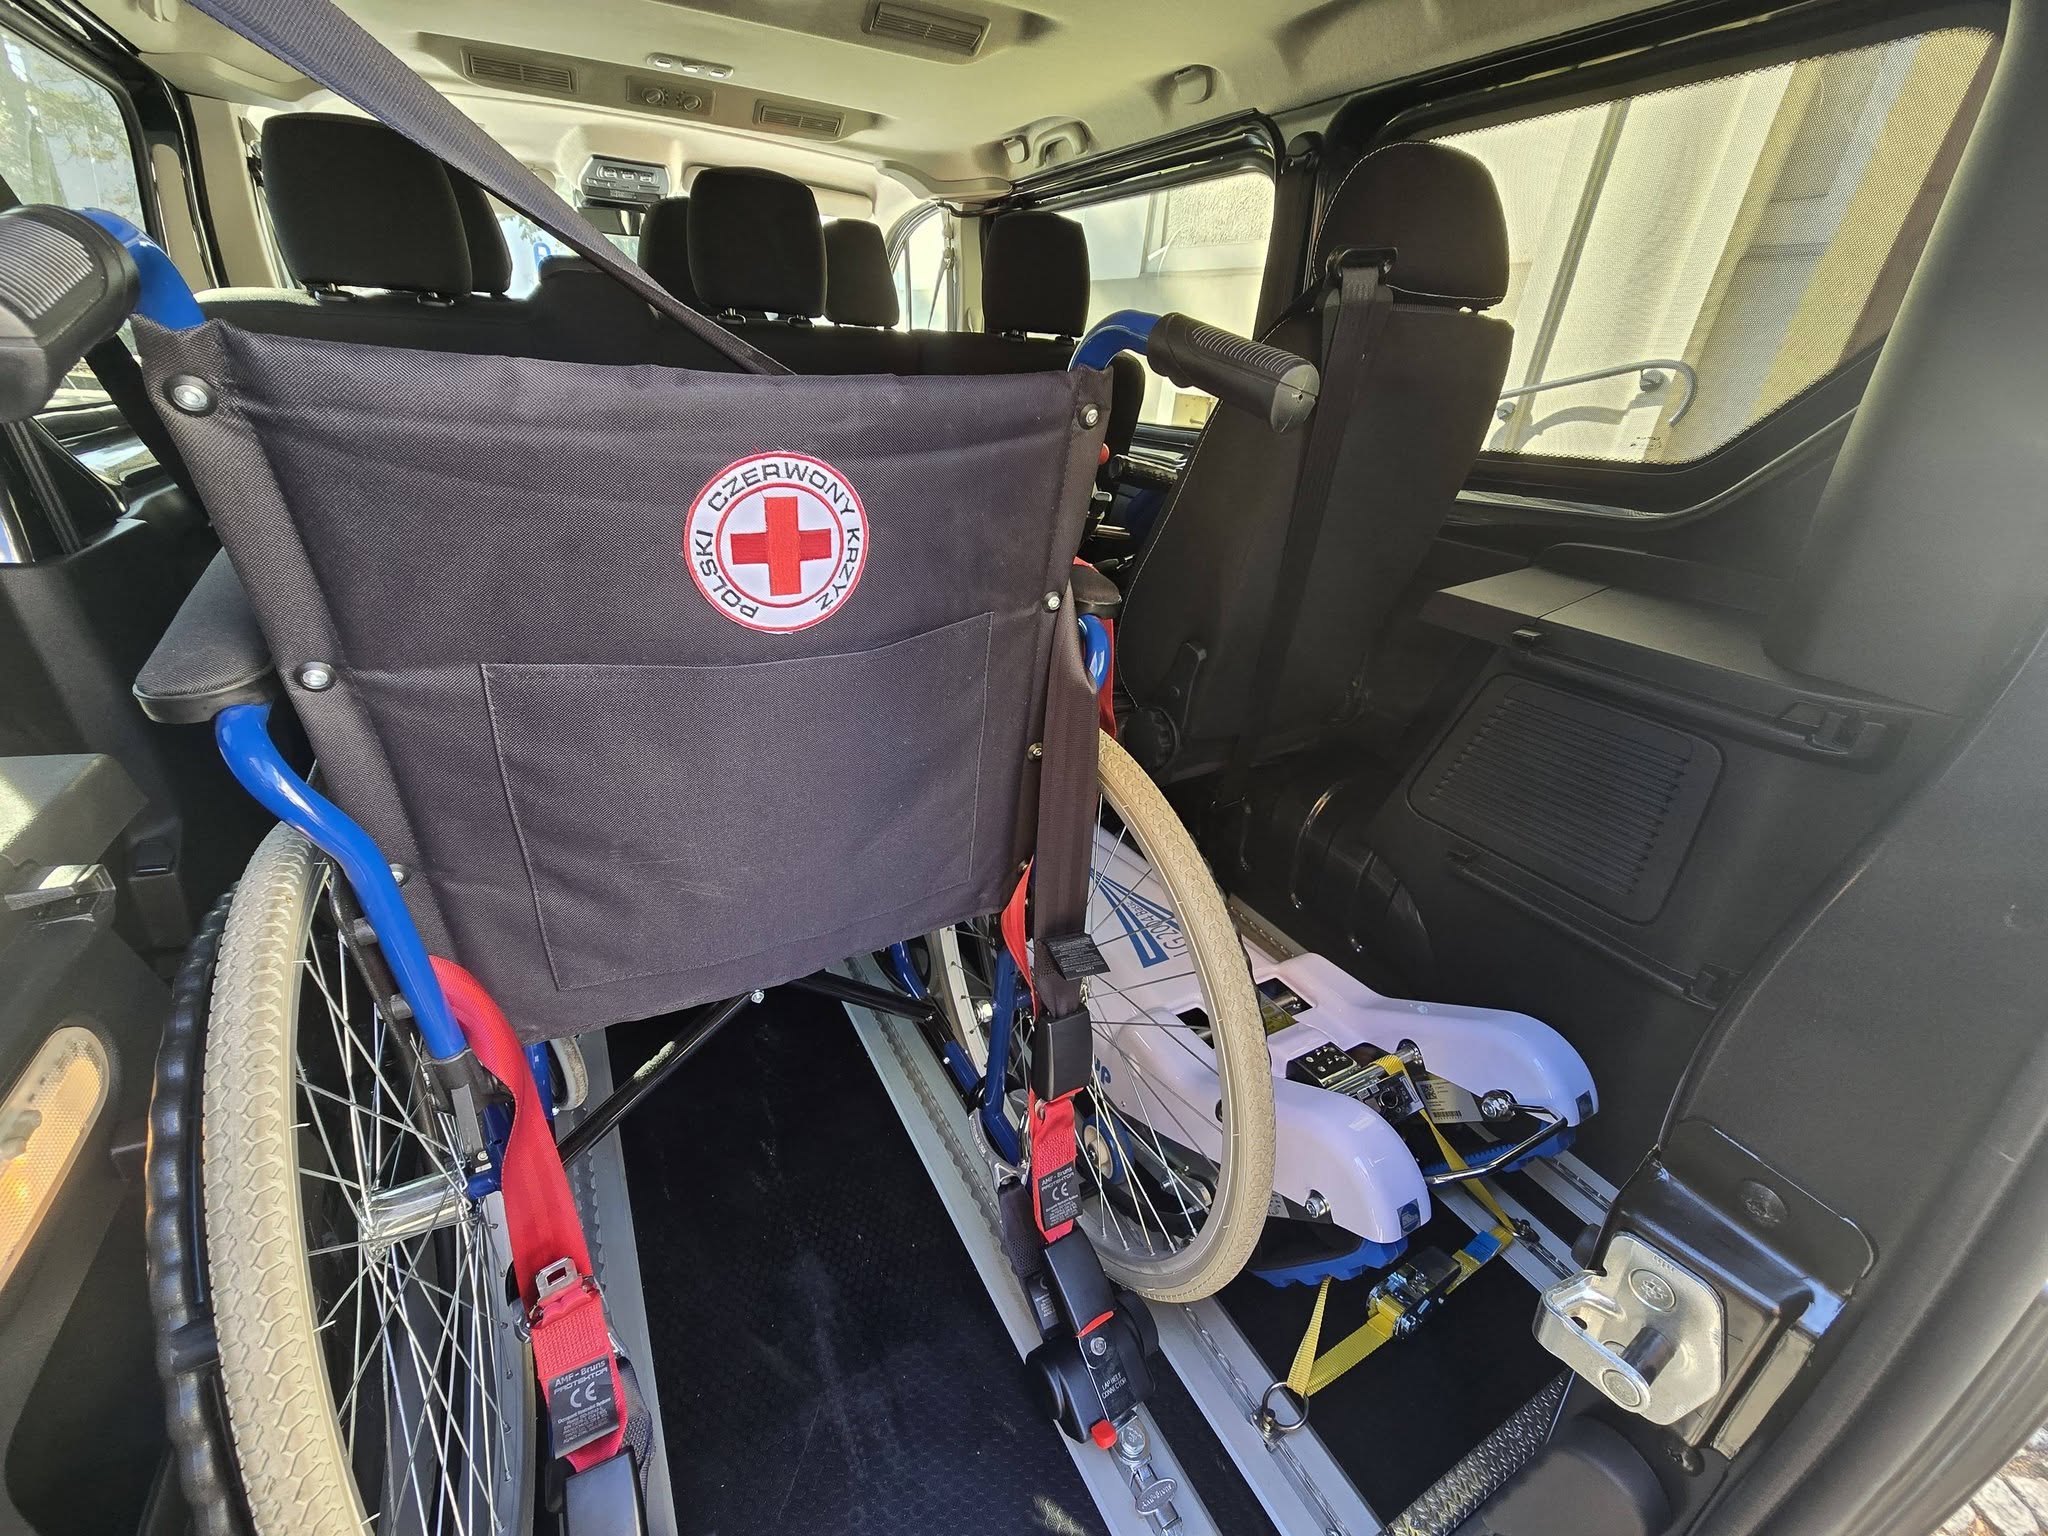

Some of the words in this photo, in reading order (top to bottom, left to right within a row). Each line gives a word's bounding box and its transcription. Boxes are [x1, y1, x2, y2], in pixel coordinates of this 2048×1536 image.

[707, 461, 856, 516] CZERWONY
[694, 529, 759, 619] POLSKI
[553, 1366, 609, 1396] PROTEKTOR
[570, 1381, 598, 1408] CE
[1101, 1379, 1111, 1391] LAP
